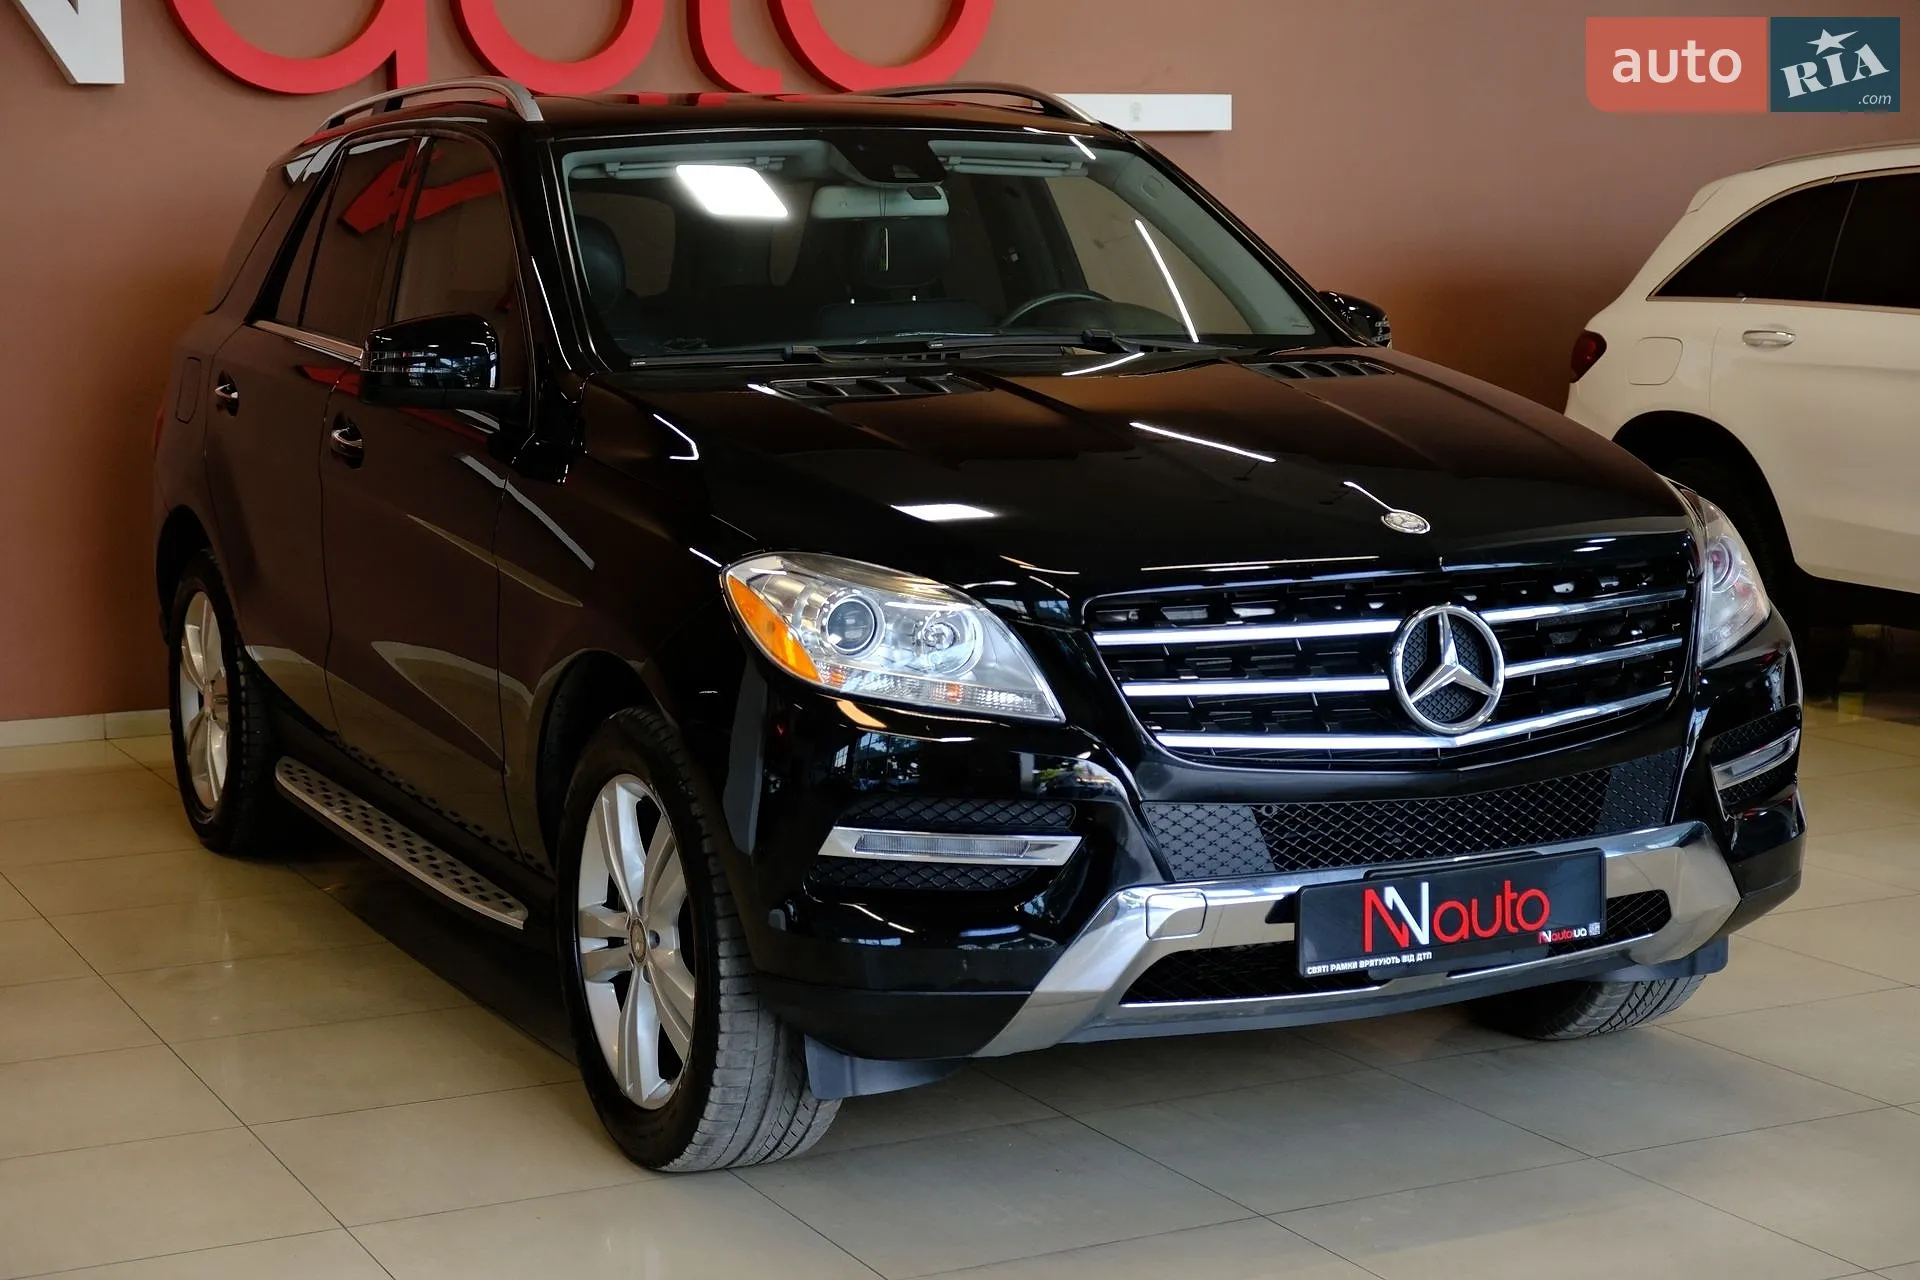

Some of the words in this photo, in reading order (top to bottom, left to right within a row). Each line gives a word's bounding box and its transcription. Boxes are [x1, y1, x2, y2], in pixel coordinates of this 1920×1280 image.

[1307, 964, 1329, 975] СВЯТІ
[1330, 961, 1358, 972] РАМКИ
[1359, 955, 1400, 968] ВРЯТУЮТЬ
[1402, 954, 1415, 963] ВІД
[1416, 951, 1432, 962] ДТП
